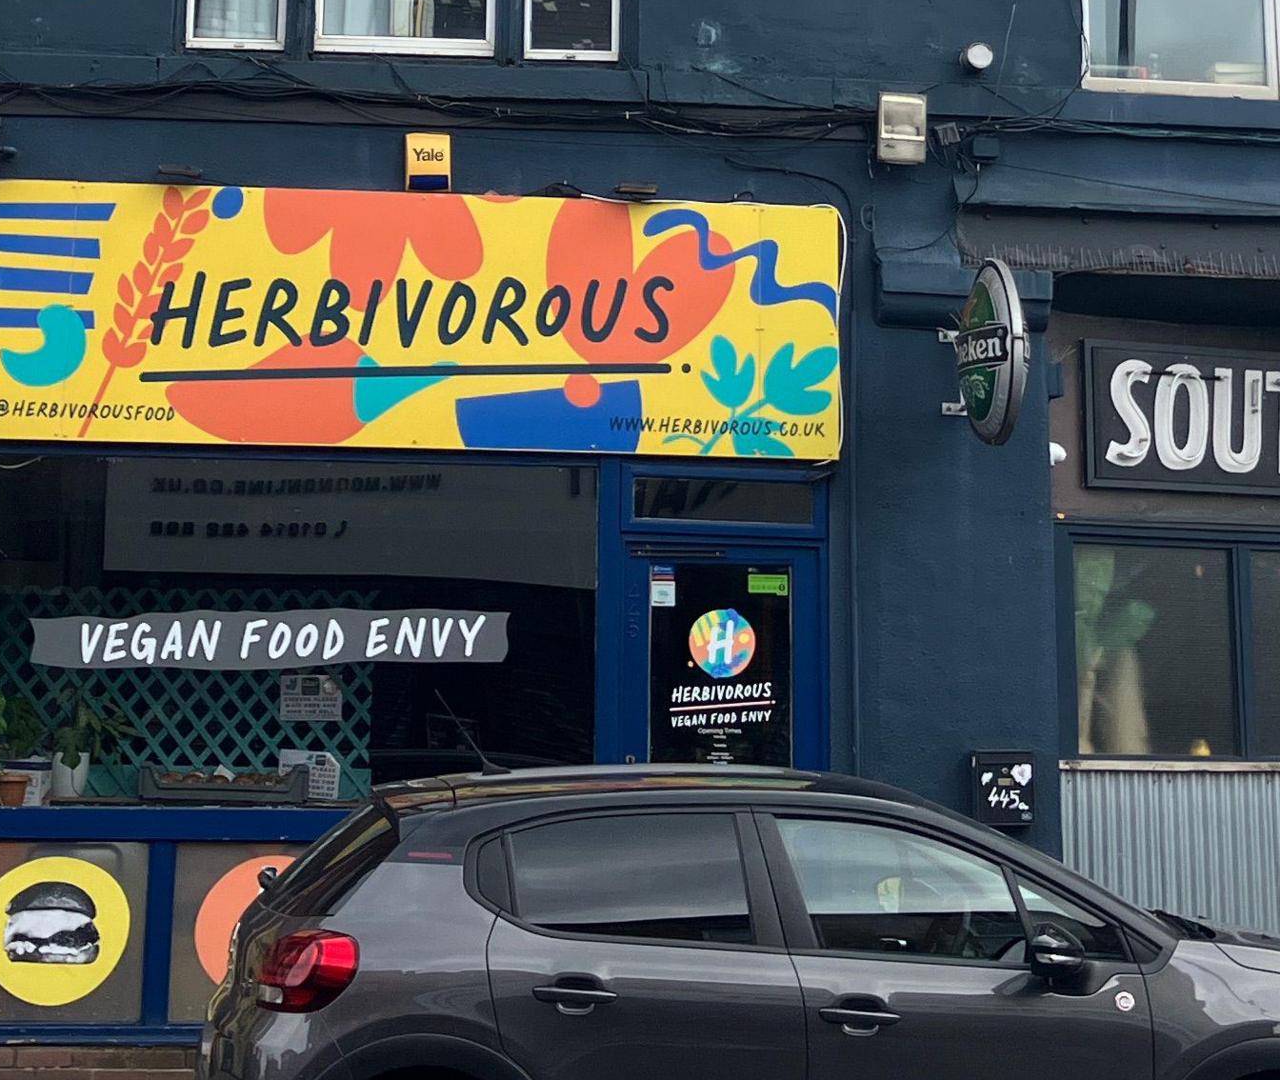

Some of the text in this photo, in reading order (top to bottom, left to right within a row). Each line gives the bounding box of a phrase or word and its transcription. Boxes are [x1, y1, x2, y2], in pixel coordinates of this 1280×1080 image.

[412, 147, 444, 162] Yale
[150, 271, 675, 350] HERBIVOROUS
[609, 416, 825, 438] WWW.HERBIVOROUS.CO.UK
[79, 614, 486, 665] VEGAN FOOD ENVY
[671, 681, 773, 703] HERBIVOROUS
[670, 709, 773, 728] VEGAN FOOD ENVY
